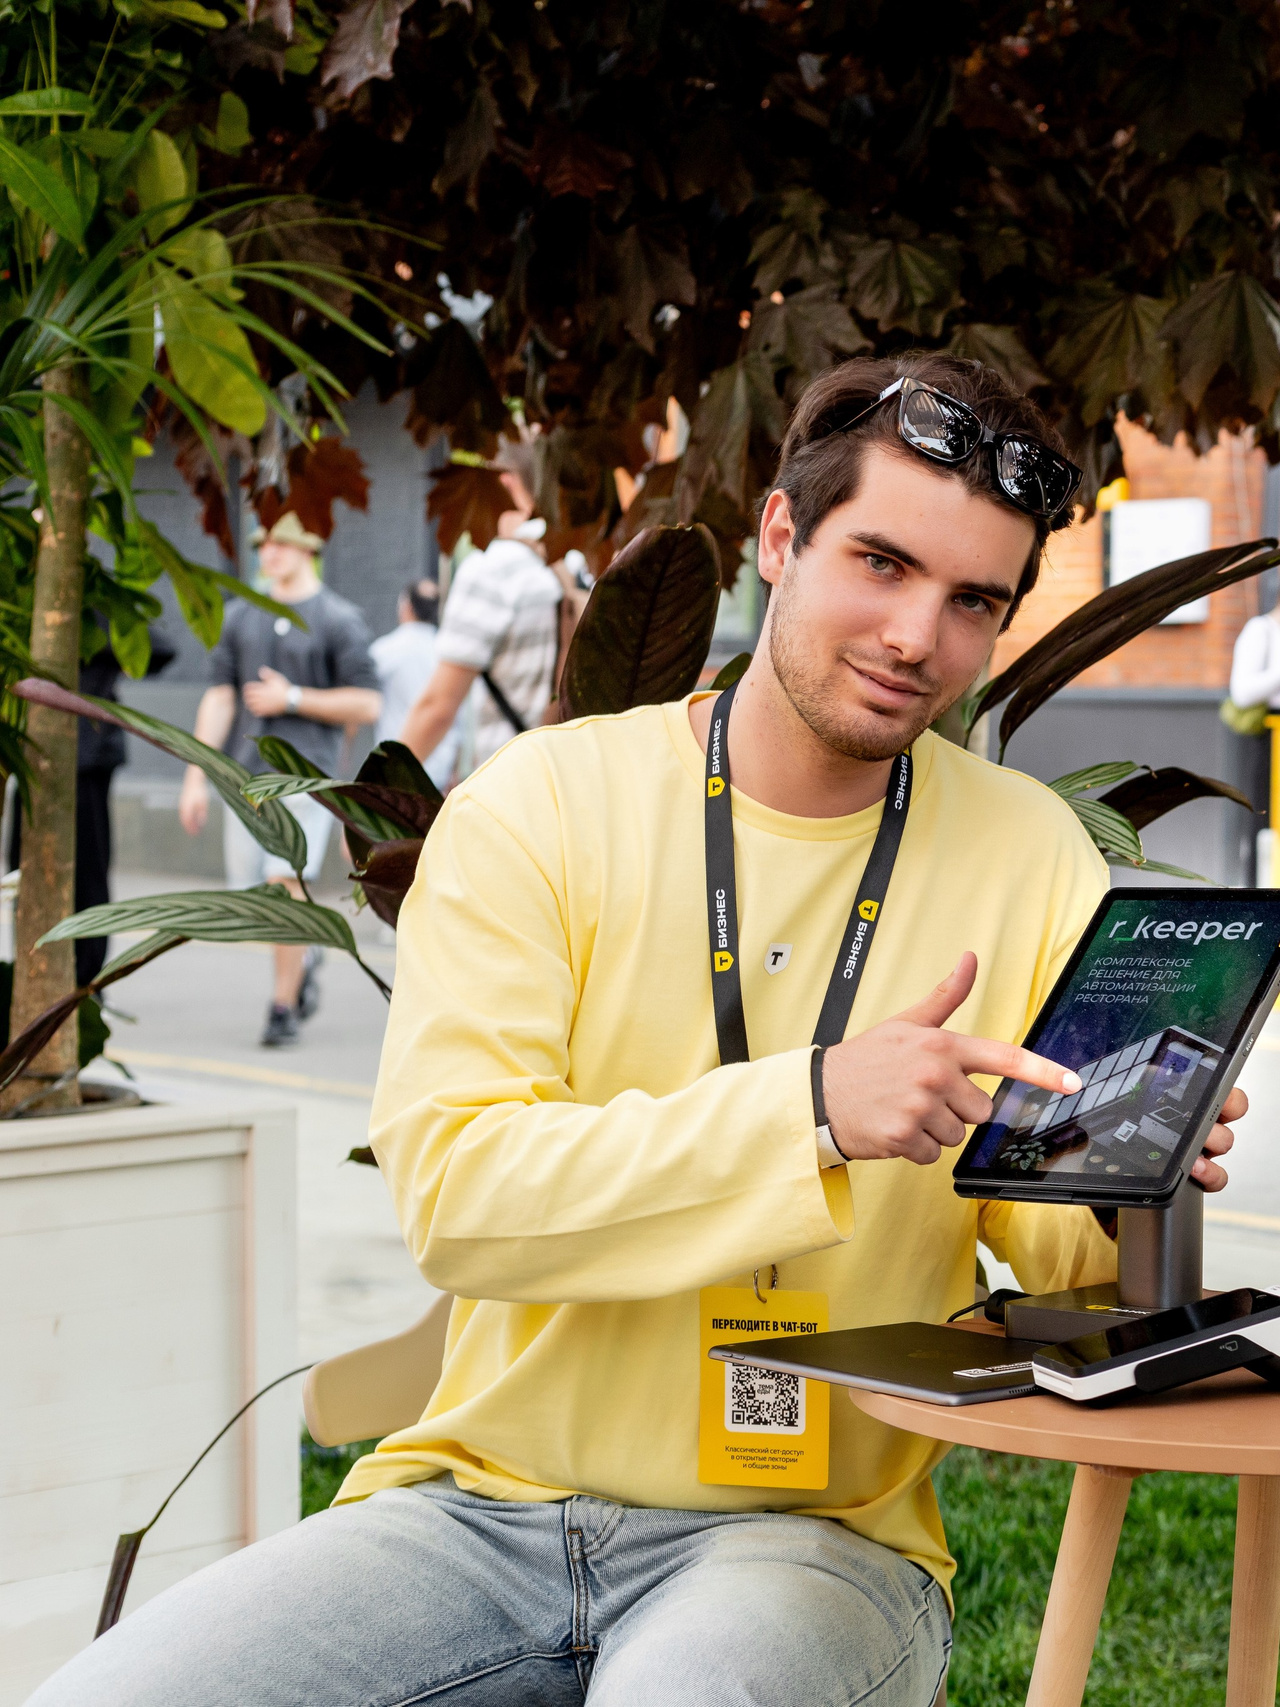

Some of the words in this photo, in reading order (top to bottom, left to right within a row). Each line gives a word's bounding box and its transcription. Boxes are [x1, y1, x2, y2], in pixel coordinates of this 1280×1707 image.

[711, 718, 722, 775] БИЗНЕС
[894, 754, 908, 810] БИЗНЕС
[715, 888, 728, 949] БИЗНЕС
[1108, 915, 1264, 946] r_keeper
[843, 921, 868, 980] БИЗНЕС
[1093, 956, 1194, 968] КОМПЛЕКСНОЕ
[1087, 968, 1152, 979] РЕШЕНИЕ
[1151, 970, 1182, 981] ДЛЯ
[1079, 981, 1197, 993] АВТОМАТИЗАЦИИ
[1073, 993, 1150, 1004] РЕСТОРАНА
[711, 1318, 771, 1333] ПЕРЕХОДИТЕ
[772, 1320, 779, 1332] В
[780, 1321, 818, 1334] ЧАТ-БОТ
[724, 1445, 769, 1454] Классический
[735, 1454, 767, 1462] открытые
[747, 1462, 770, 1470] общие
